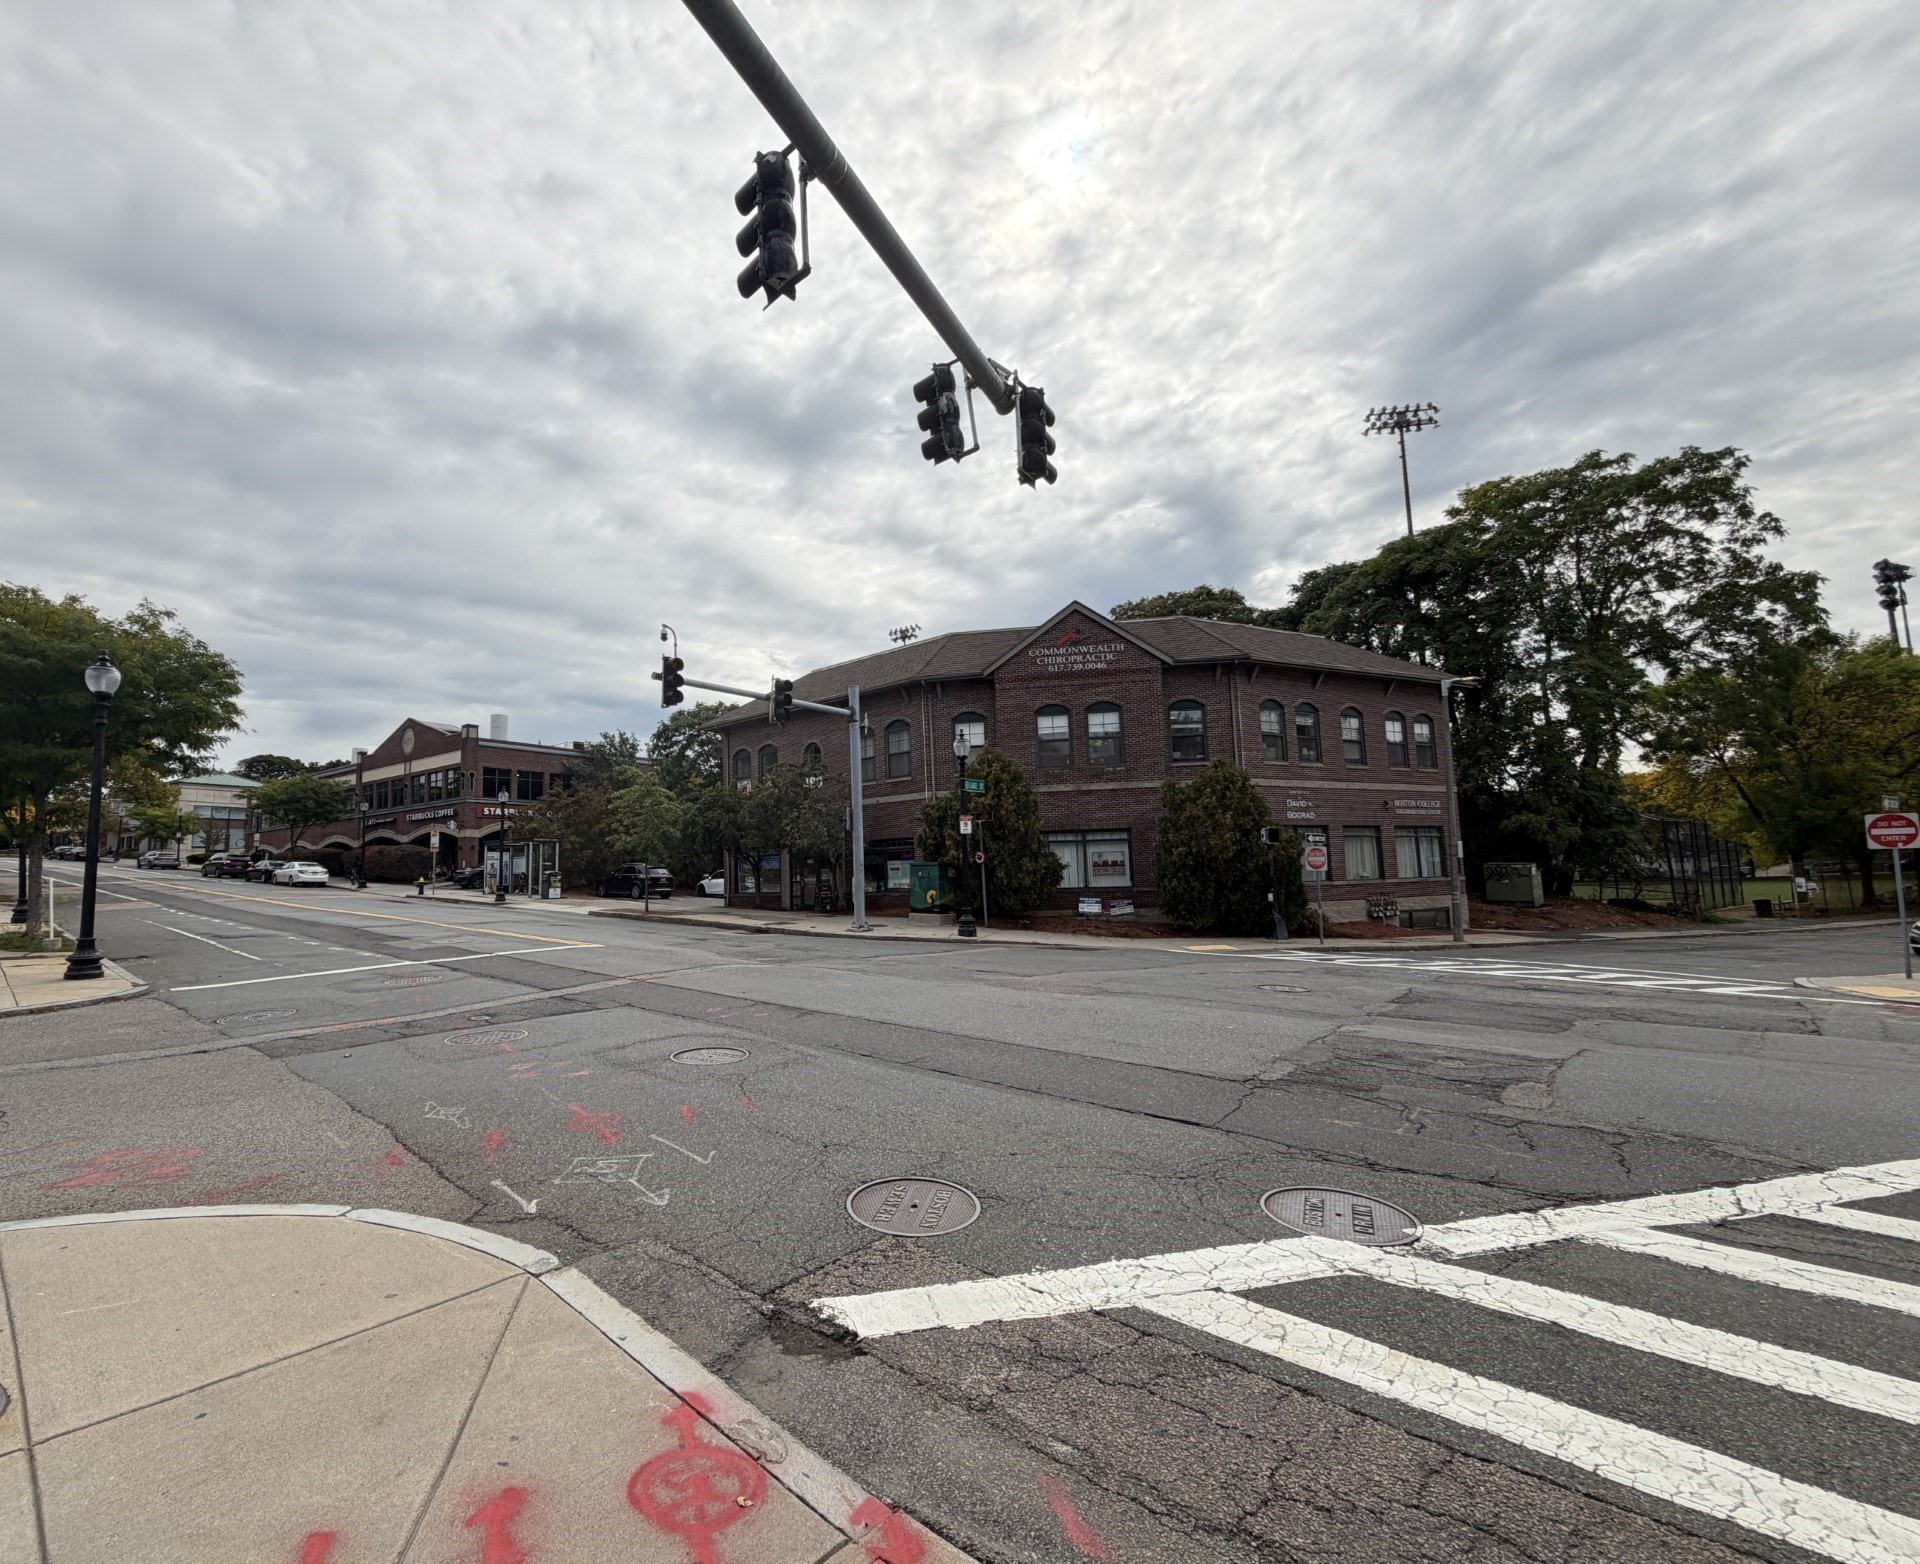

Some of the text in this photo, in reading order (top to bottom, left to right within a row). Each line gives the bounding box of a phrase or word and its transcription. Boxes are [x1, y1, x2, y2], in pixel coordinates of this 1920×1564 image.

[1028, 643, 1124, 657] COMMONWEALTH
[1036, 652, 1118, 665] CHIROPRACTIC
[1048, 662, 1107, 672] 617.739.0046
[1286, 799, 1307, 807] DAVID
[1394, 799, 1441, 808] BOSTON COLLEGE
[405, 811, 434, 822] STARBUCKS
[434, 808, 454, 817] COFFEE
[1286, 811, 1315, 819] BOGRAD
[873, 1183, 909, 1223] SEWER
[919, 1189, 954, 1229] BOSTON
[1304, 1196, 1324, 1227] BOSTON
[1352, 1203, 1375, 1234] DRAIN
